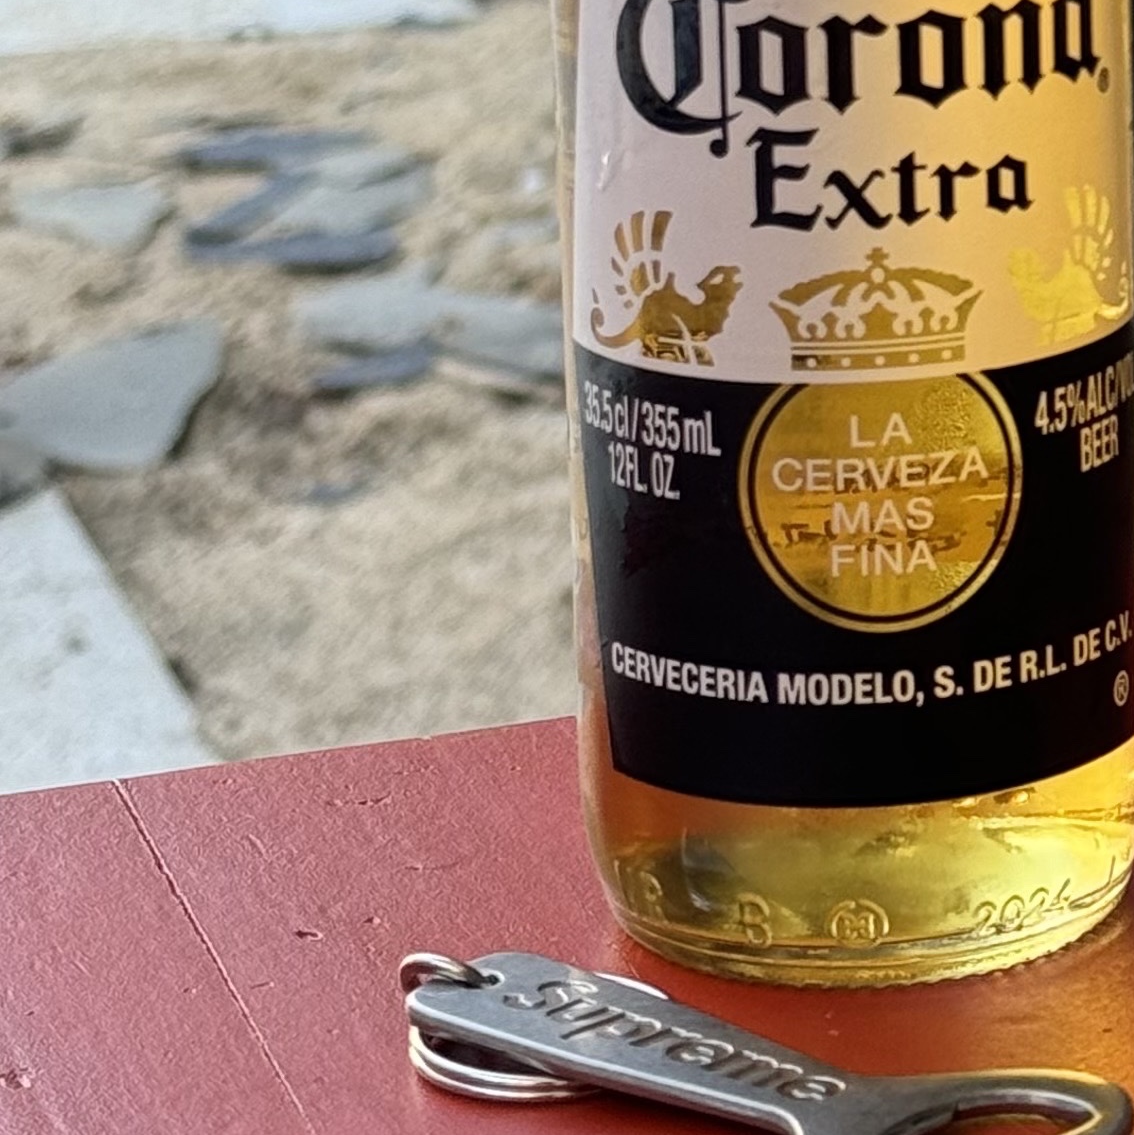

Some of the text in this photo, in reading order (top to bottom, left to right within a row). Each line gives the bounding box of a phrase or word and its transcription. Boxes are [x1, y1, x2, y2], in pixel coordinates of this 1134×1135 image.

[745, 127, 1034, 232] Extra
[850, 413, 912, 448] LA
[1081, 414, 1119, 473] BEER
[772, 446, 989, 492] CERVEZA
[831, 496, 935, 535] MAS
[831, 539, 937, 578] FINA
[611, 641, 769, 704] CERVECERIA
[777, 669, 925, 707] MODELO,
[934, 665, 964, 699] S.
[973, 655, 1013, 693] DE
[1019, 644, 1067, 683] R.L.
[1073, 627, 1101, 666] DE
[503, 980, 847, 1101] Supreme
